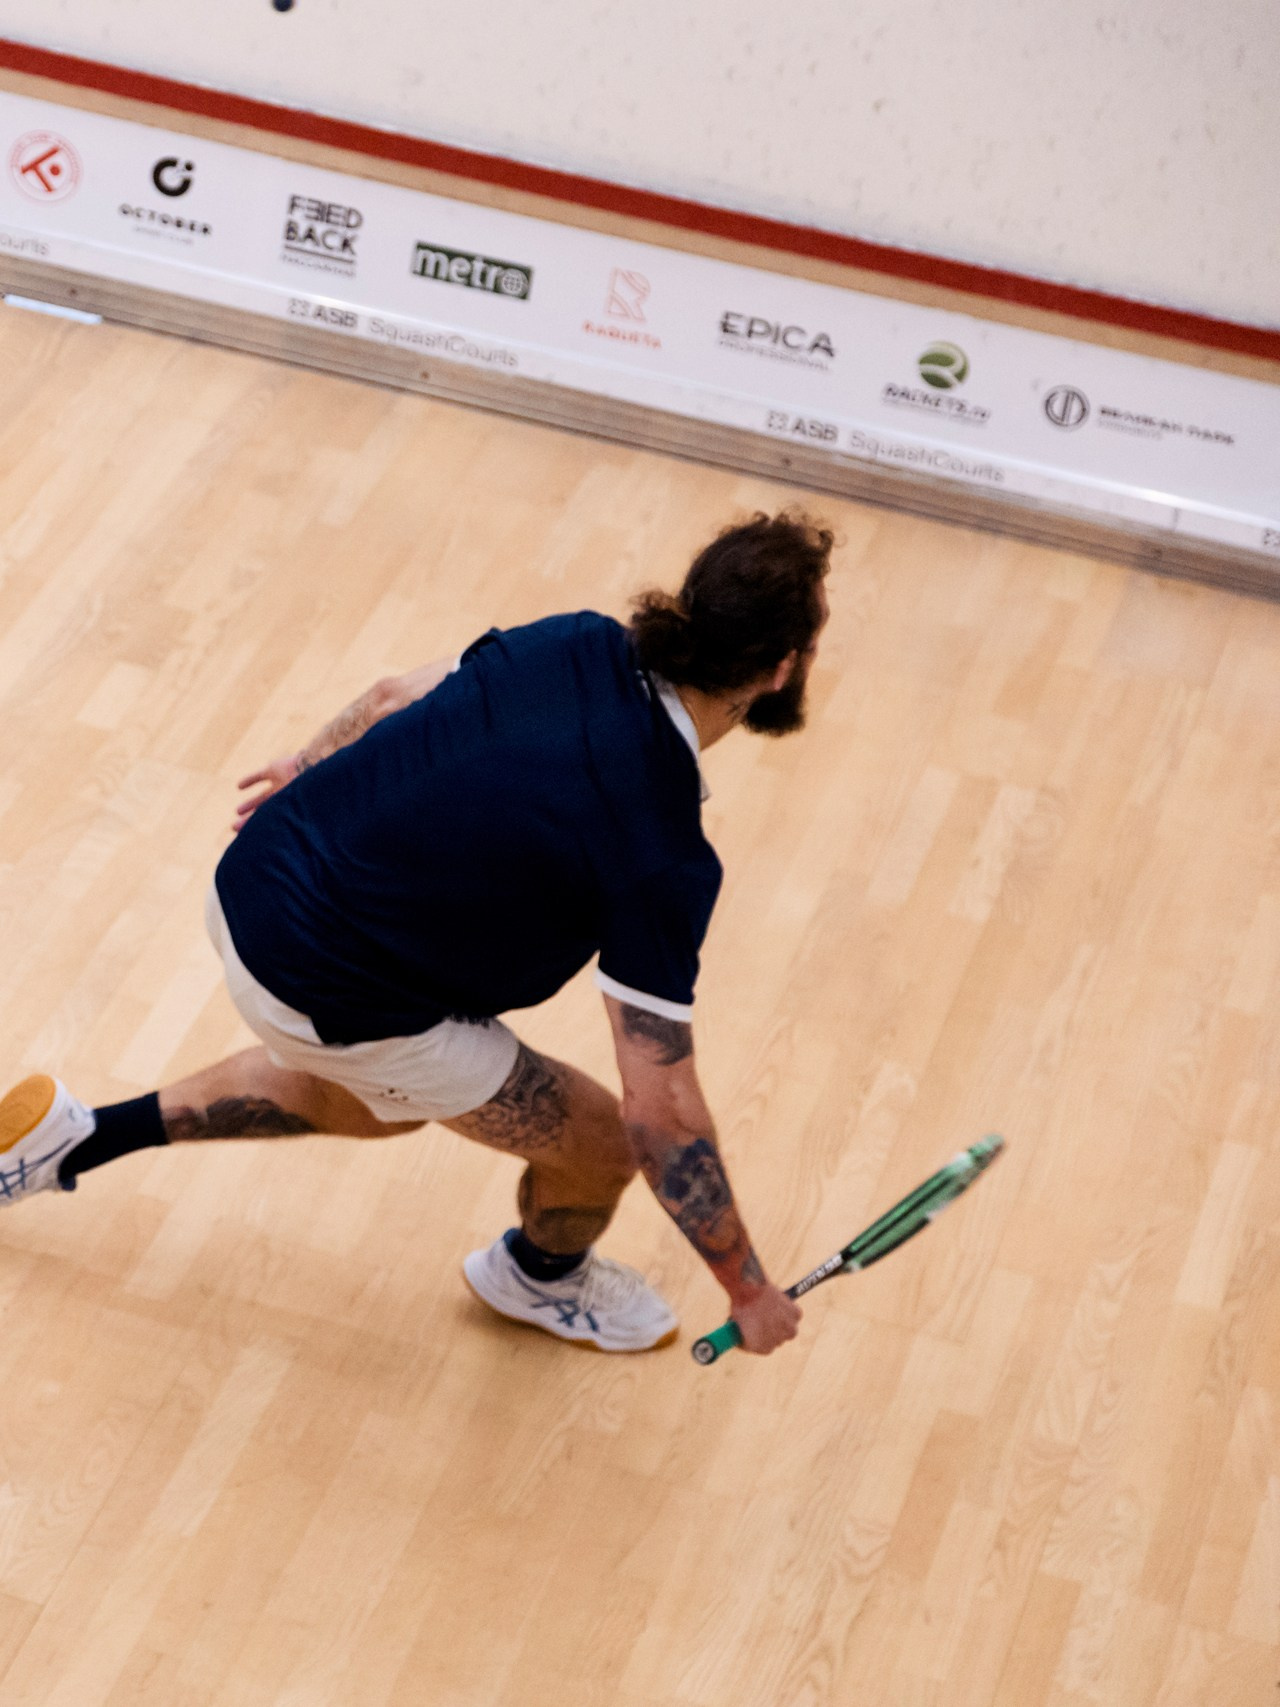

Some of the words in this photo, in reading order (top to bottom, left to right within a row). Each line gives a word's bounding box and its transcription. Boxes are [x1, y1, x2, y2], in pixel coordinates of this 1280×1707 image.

[119, 203, 213, 236] OCTOBER
[284, 219, 358, 256] BACK
[416, 250, 531, 296] metro
[316, 303, 358, 330] ASB
[369, 314, 519, 368] SquashCourts
[720, 309, 836, 359] EPICA
[792, 417, 838, 443] ASB
[850, 428, 1007, 485] SquashCourts
